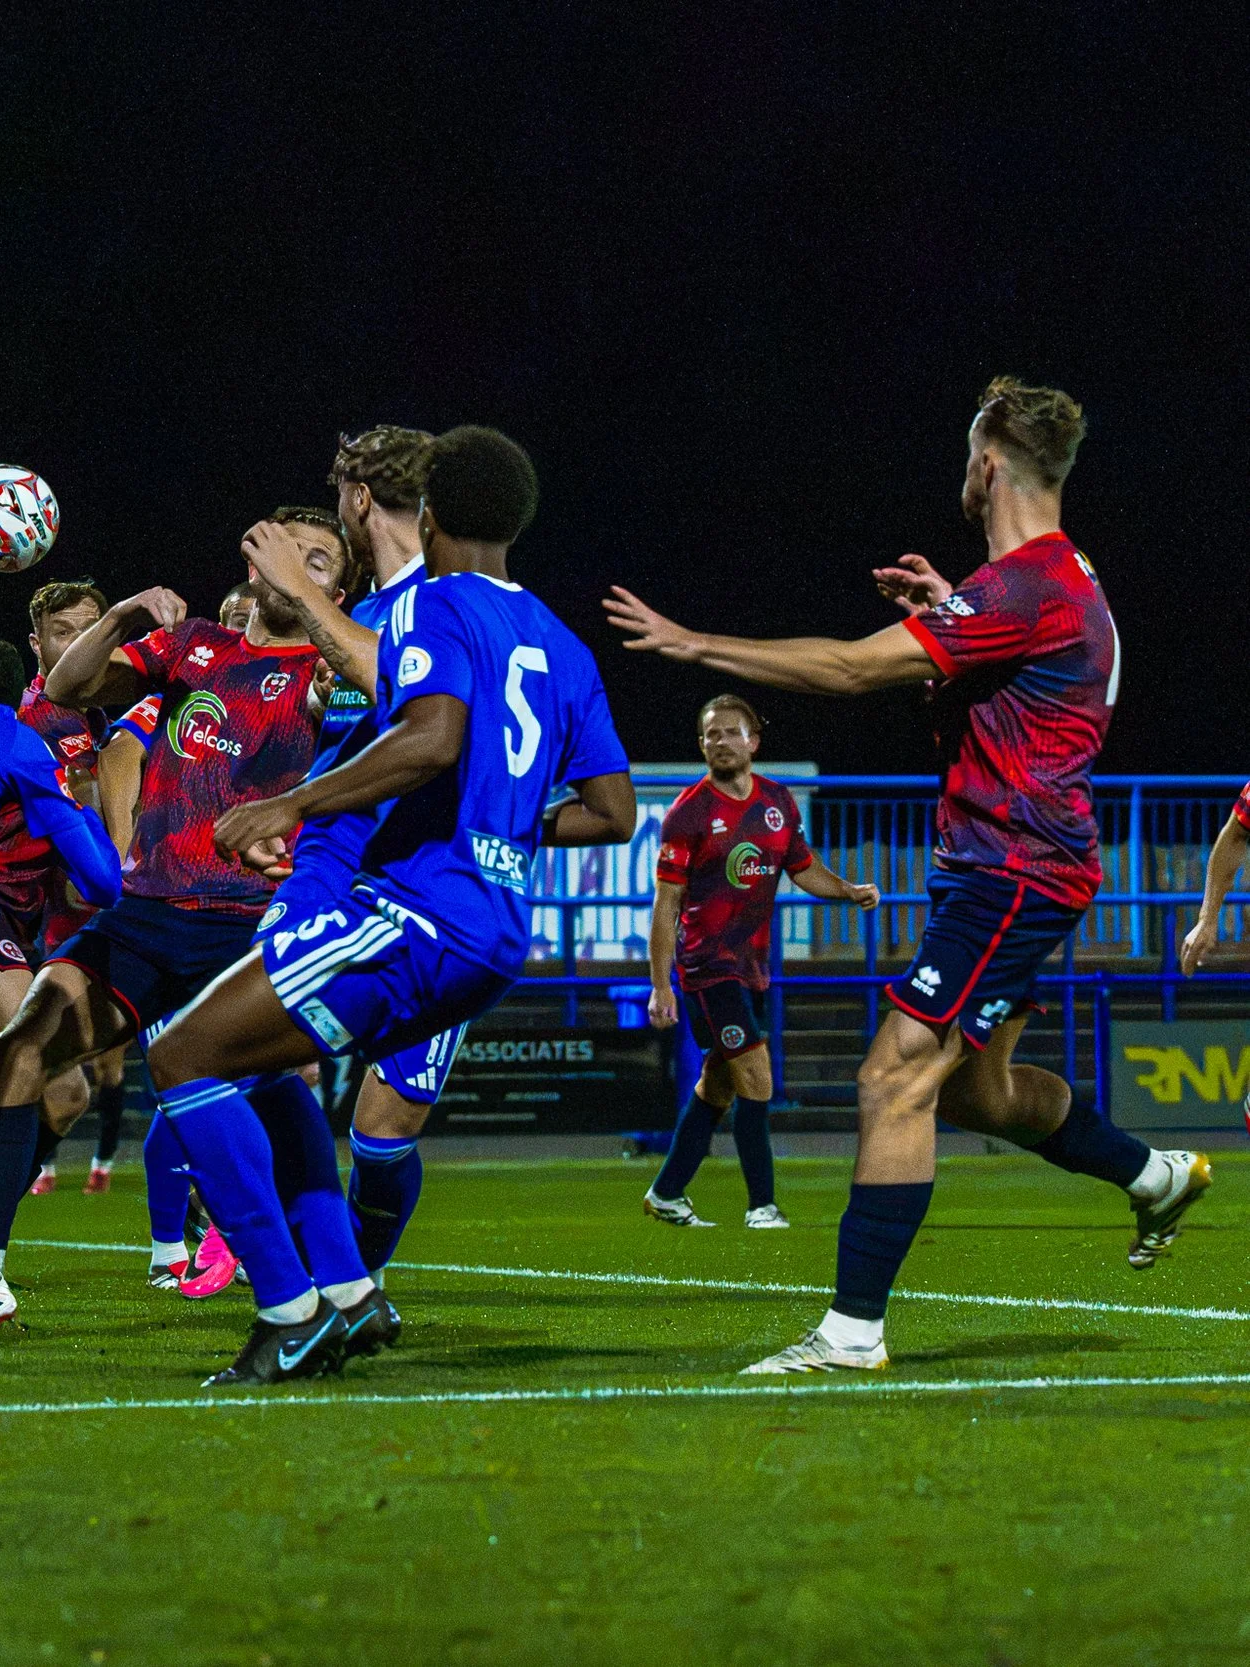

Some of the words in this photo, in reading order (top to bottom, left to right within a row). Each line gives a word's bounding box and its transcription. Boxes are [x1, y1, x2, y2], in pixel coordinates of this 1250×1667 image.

[504, 646, 549, 778] 5
[297, 909, 348, 941] 5
[456, 1040, 595, 1062] ASSOCIATES
